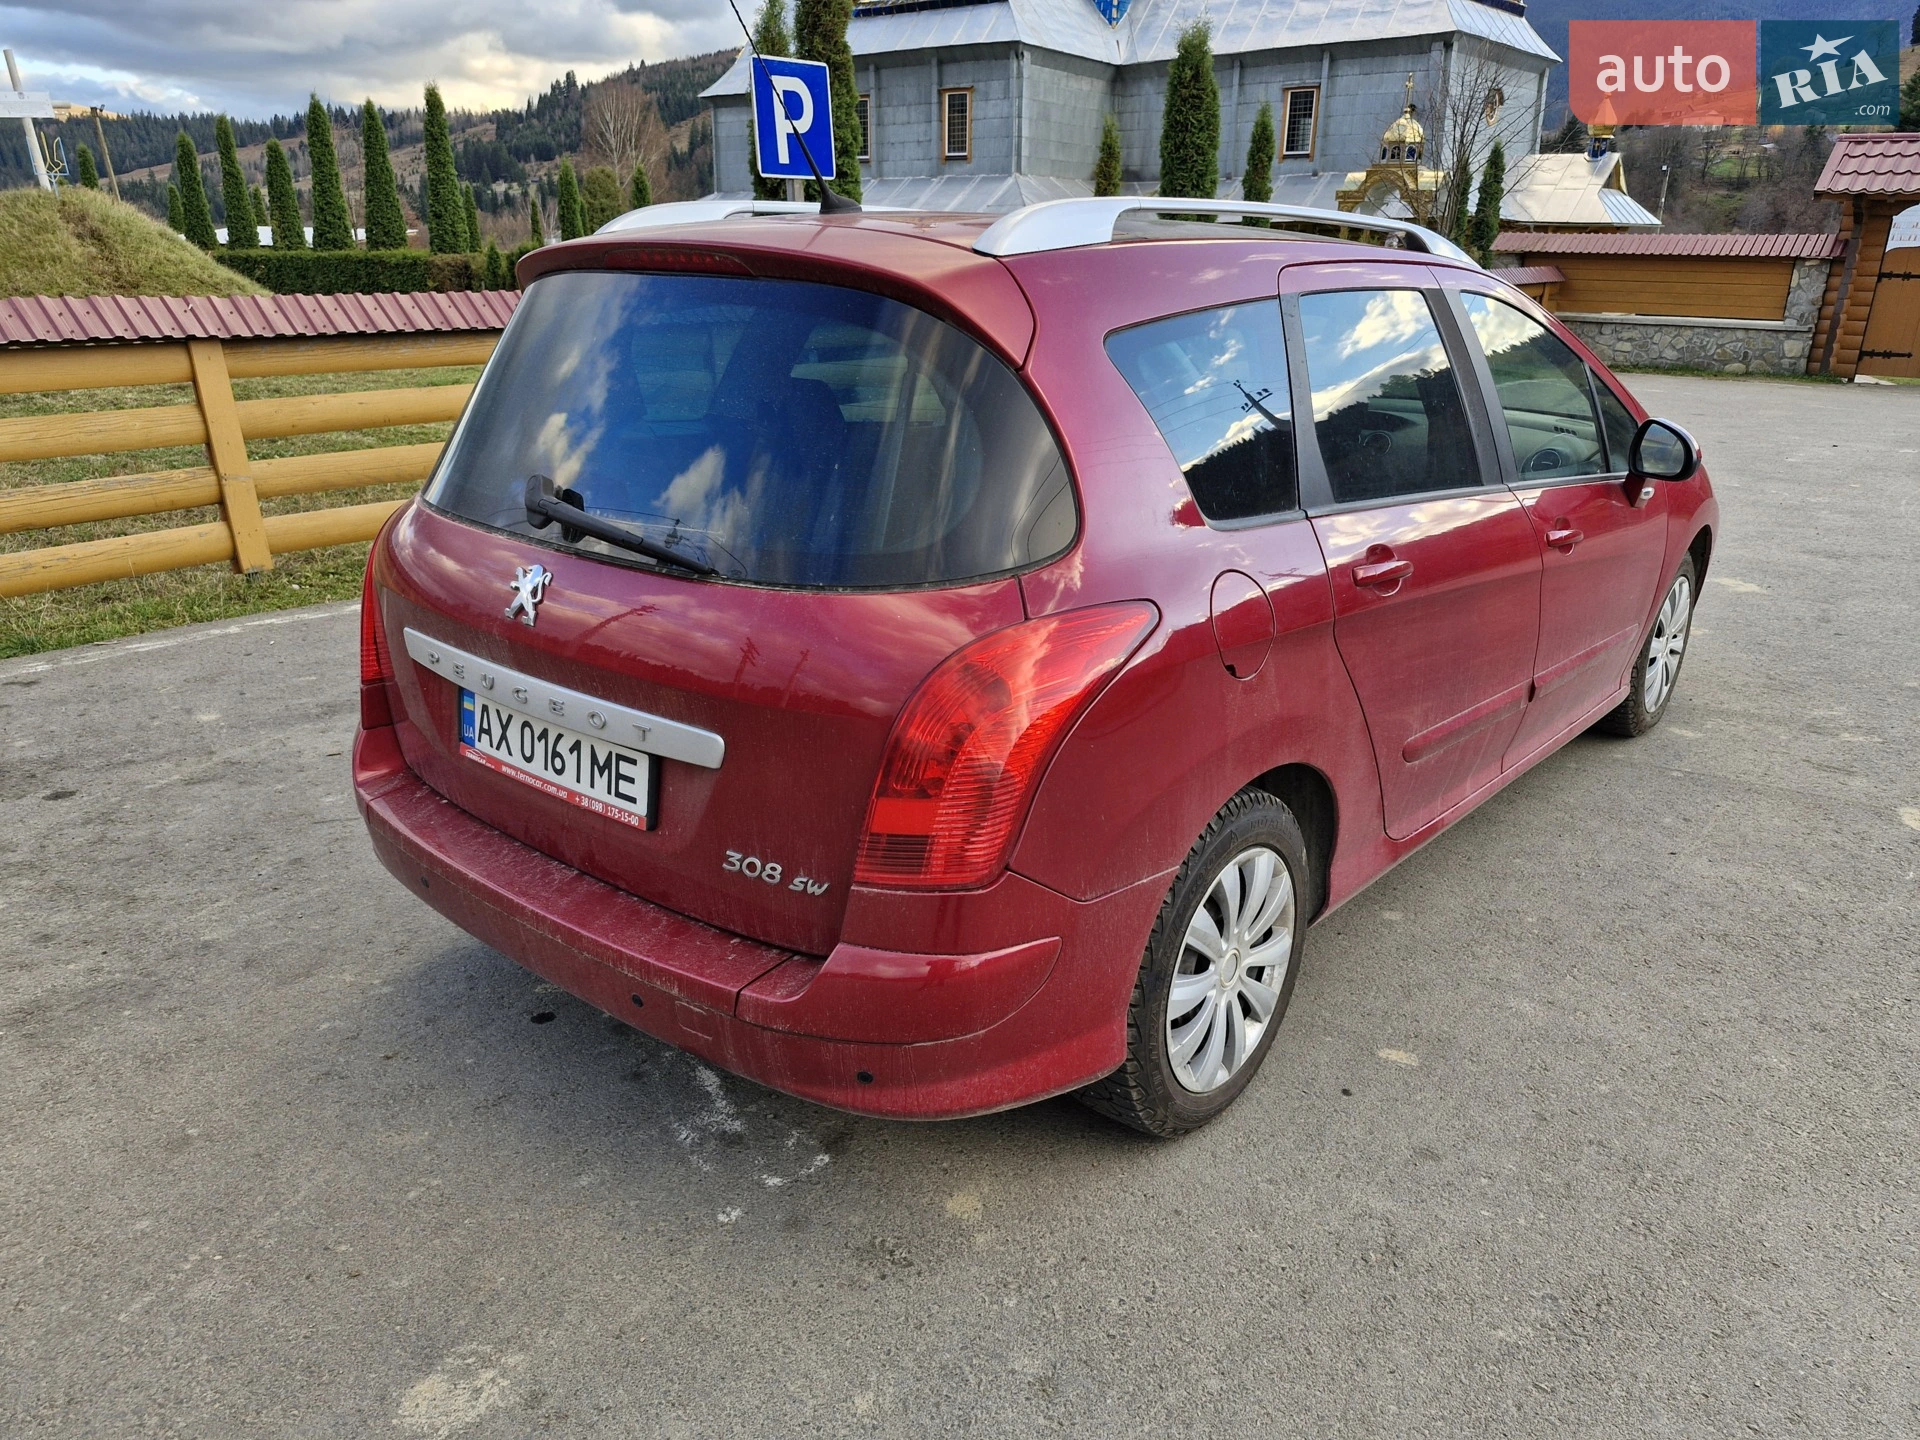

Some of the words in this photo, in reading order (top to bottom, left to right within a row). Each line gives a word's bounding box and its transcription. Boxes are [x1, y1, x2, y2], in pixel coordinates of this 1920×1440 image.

[770, 75, 814, 164] P
[427, 649, 651, 742] PEUGEOT
[463, 725, 475, 740] UA
[477, 704, 514, 757] AX
[520, 720, 582, 784] 0161
[590, 744, 638, 805] ME
[501, 765, 568, 799] www.ternocar.com.ua
[607, 807, 639, 826] 175-15-00
[722, 850, 783, 884] 308
